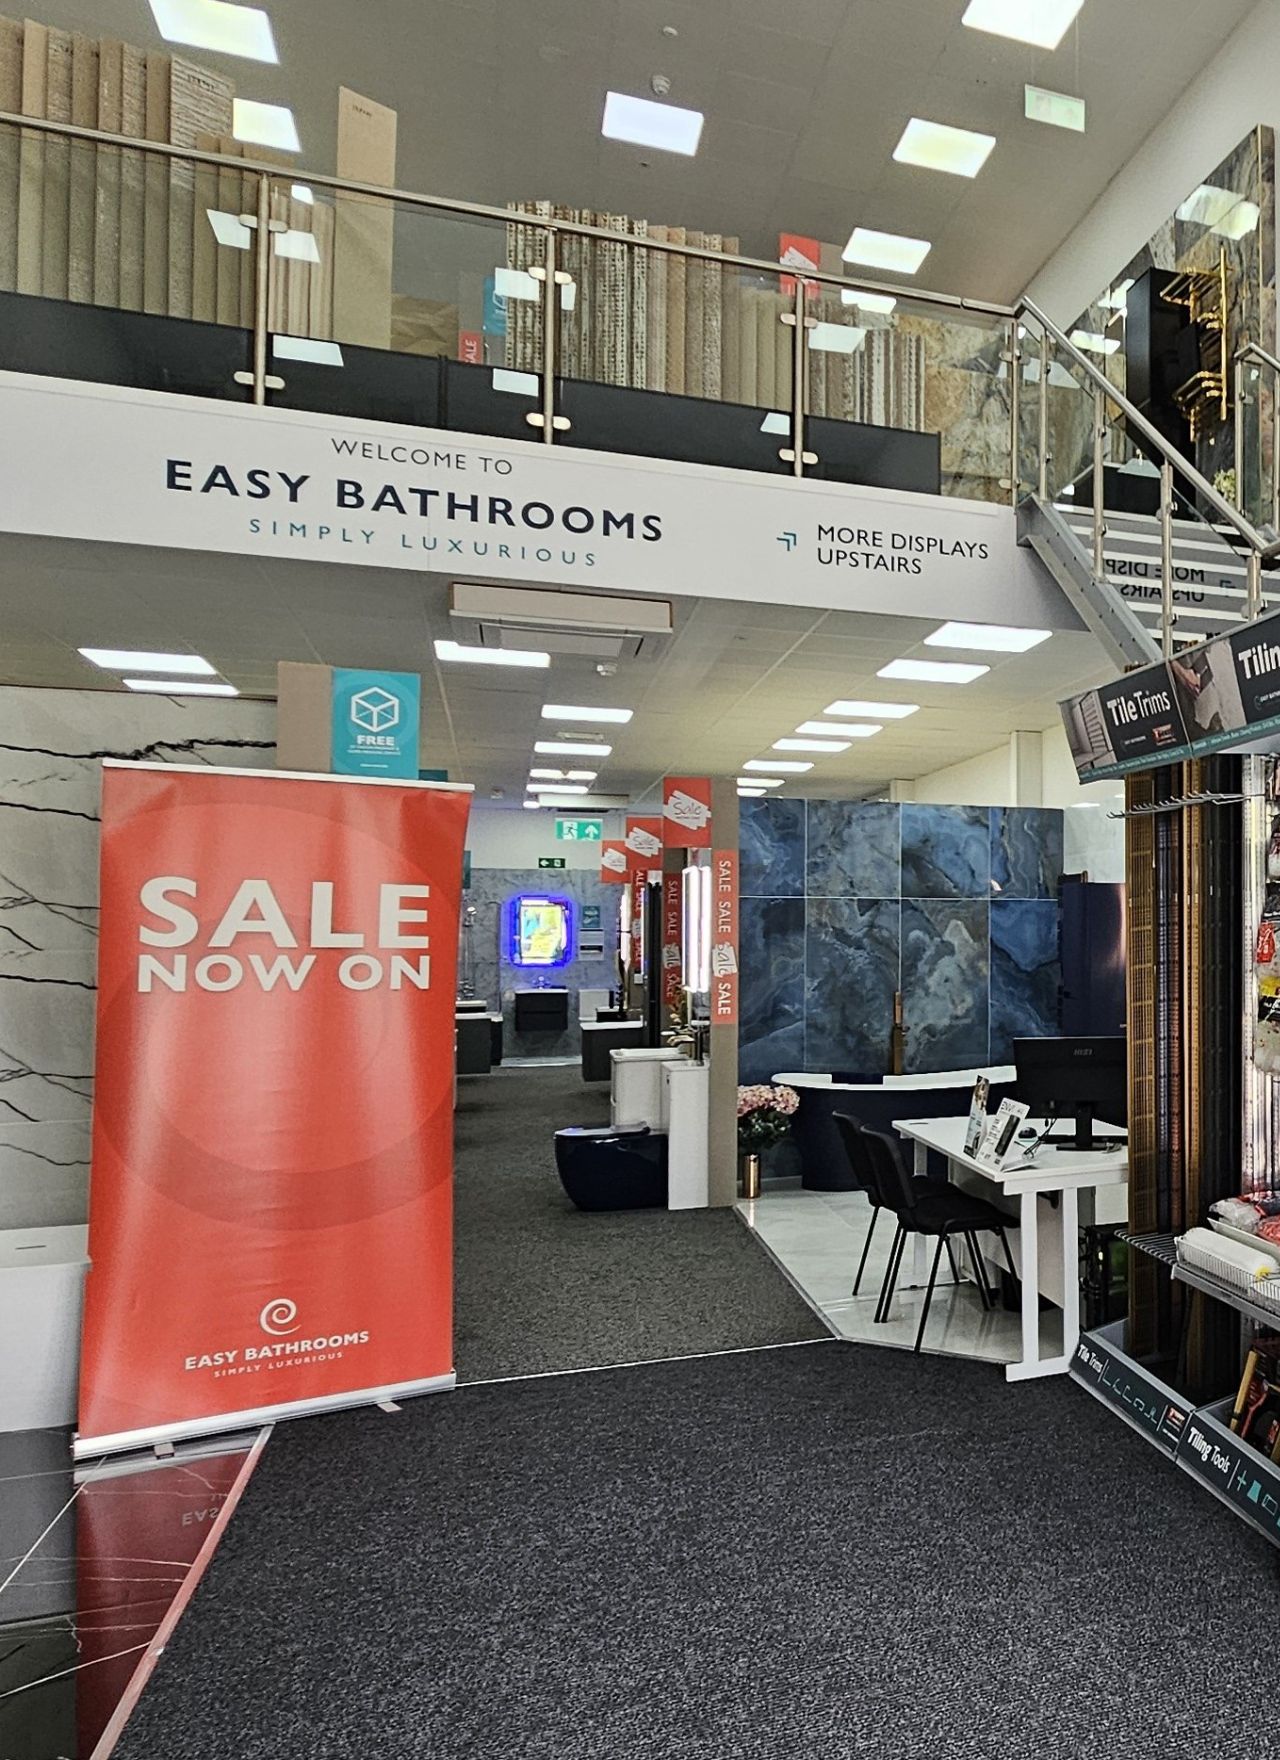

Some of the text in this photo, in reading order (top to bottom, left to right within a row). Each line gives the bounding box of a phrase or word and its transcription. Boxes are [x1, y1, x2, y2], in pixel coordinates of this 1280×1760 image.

[465, 339, 477, 363] ALE
[331, 437, 513, 475] WELCOME TO
[166, 459, 664, 542] EASY BATHROOMS
[249, 518, 597, 567] SIMPLY LUXURIOUS
[818, 525, 989, 560] MORE DISPLAYS
[817, 547, 922, 575] UPSTAIRS
[1107, 690, 1171, 727] Tile Trims
[356, 735, 395, 746] FREE
[668, 881, 678, 904] SALE
[719, 860, 732, 892] SALE
[138, 876, 431, 949] SALE
[668, 912, 677, 935] SALE
[719, 901, 732, 933] SALE
[137, 953, 431, 993] NOW ON
[718, 982, 732, 1015] SALE
[184, 1331, 370, 1371] EASY BATHROOMS
[213, 1352, 344, 1378] SIMPLY LUXURIOUS
[1078, 1344, 1088, 1362] Tile
[1187, 1427, 1231, 1473] Tiling Tools
